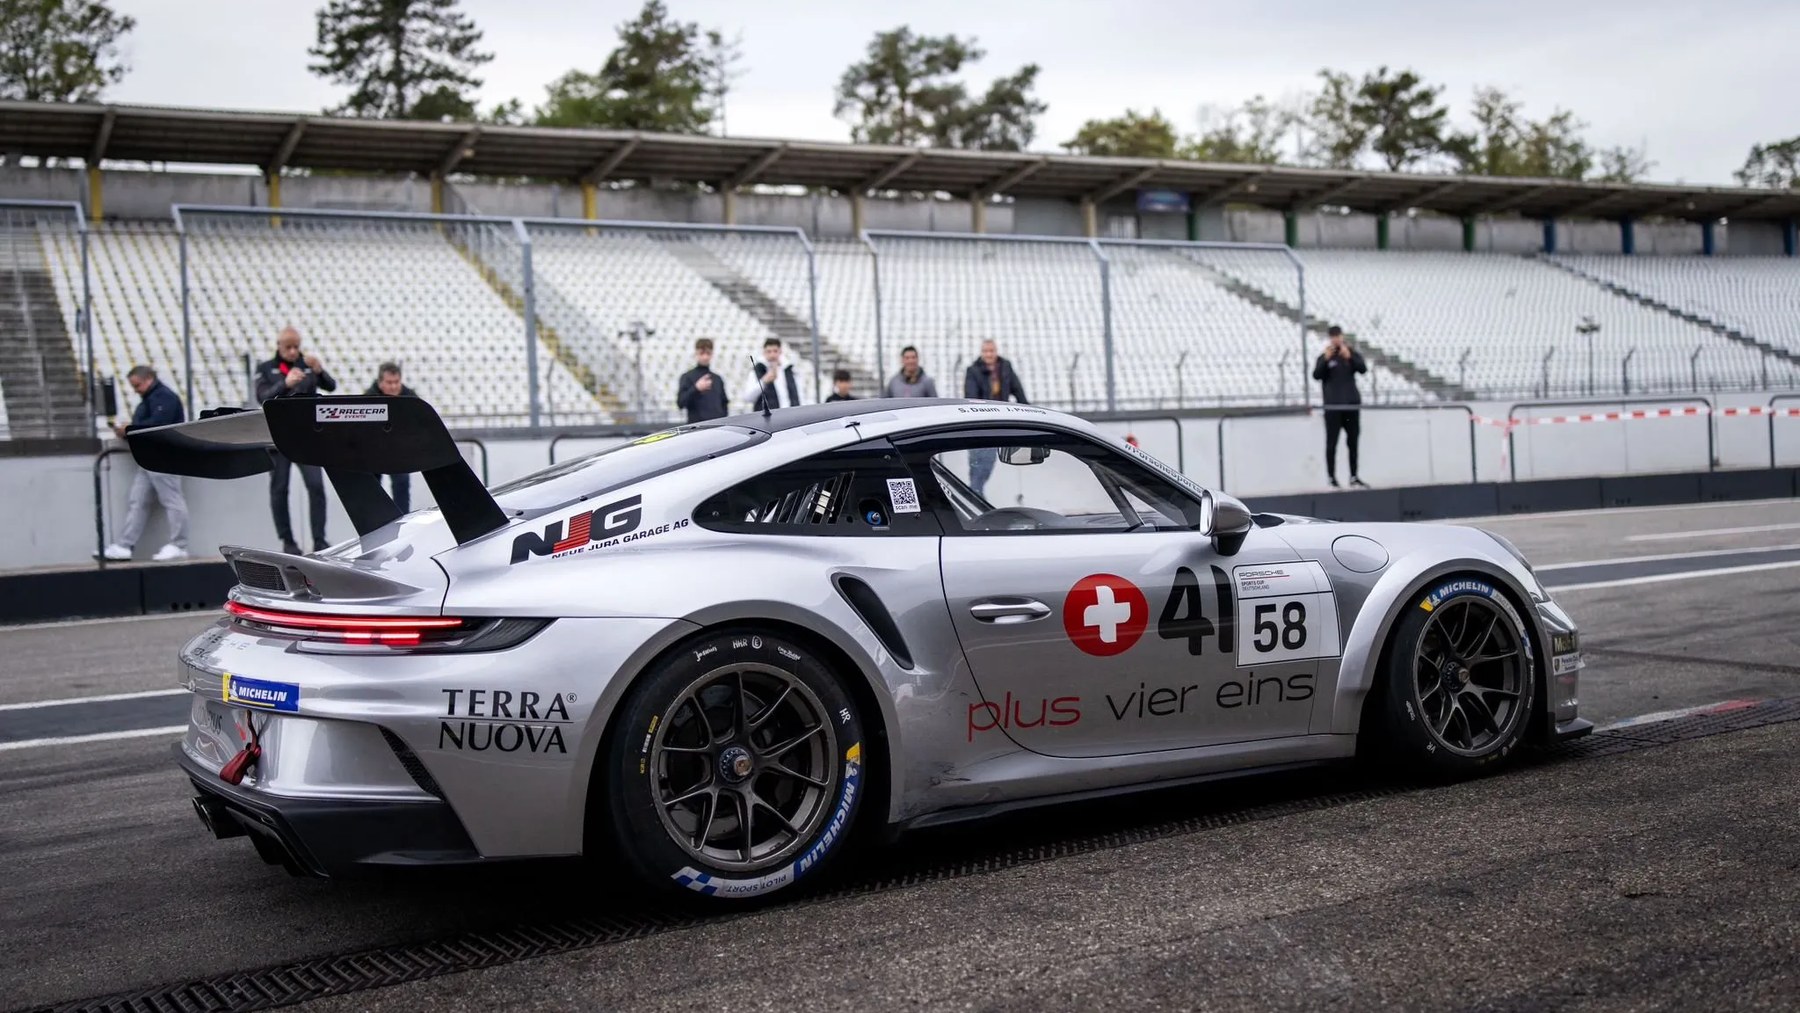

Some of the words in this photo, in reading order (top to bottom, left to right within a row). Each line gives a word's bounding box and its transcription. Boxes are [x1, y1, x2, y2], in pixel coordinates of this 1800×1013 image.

[551, 547, 585, 559] NEUE
[588, 539, 620, 551] JURA
[623, 524, 670, 543] GARAGE
[673, 518, 689, 531] AG
[1439, 581, 1489, 598] MICHELIN
[1158, 564, 1234, 656] 41
[1253, 601, 1307, 653] 58
[239, 686, 288, 702] MICHELIN
[968, 690, 1081, 742] plus
[1105, 682, 1199, 721] vier
[1216, 671, 1314, 708] eins
[839, 707, 851, 725] HR
[439, 721, 567, 753] NUOVA
[800, 782, 855, 872] MICHELIN
[726, 884, 758, 893] SPORT
[761, 874, 787, 890] PILOT
